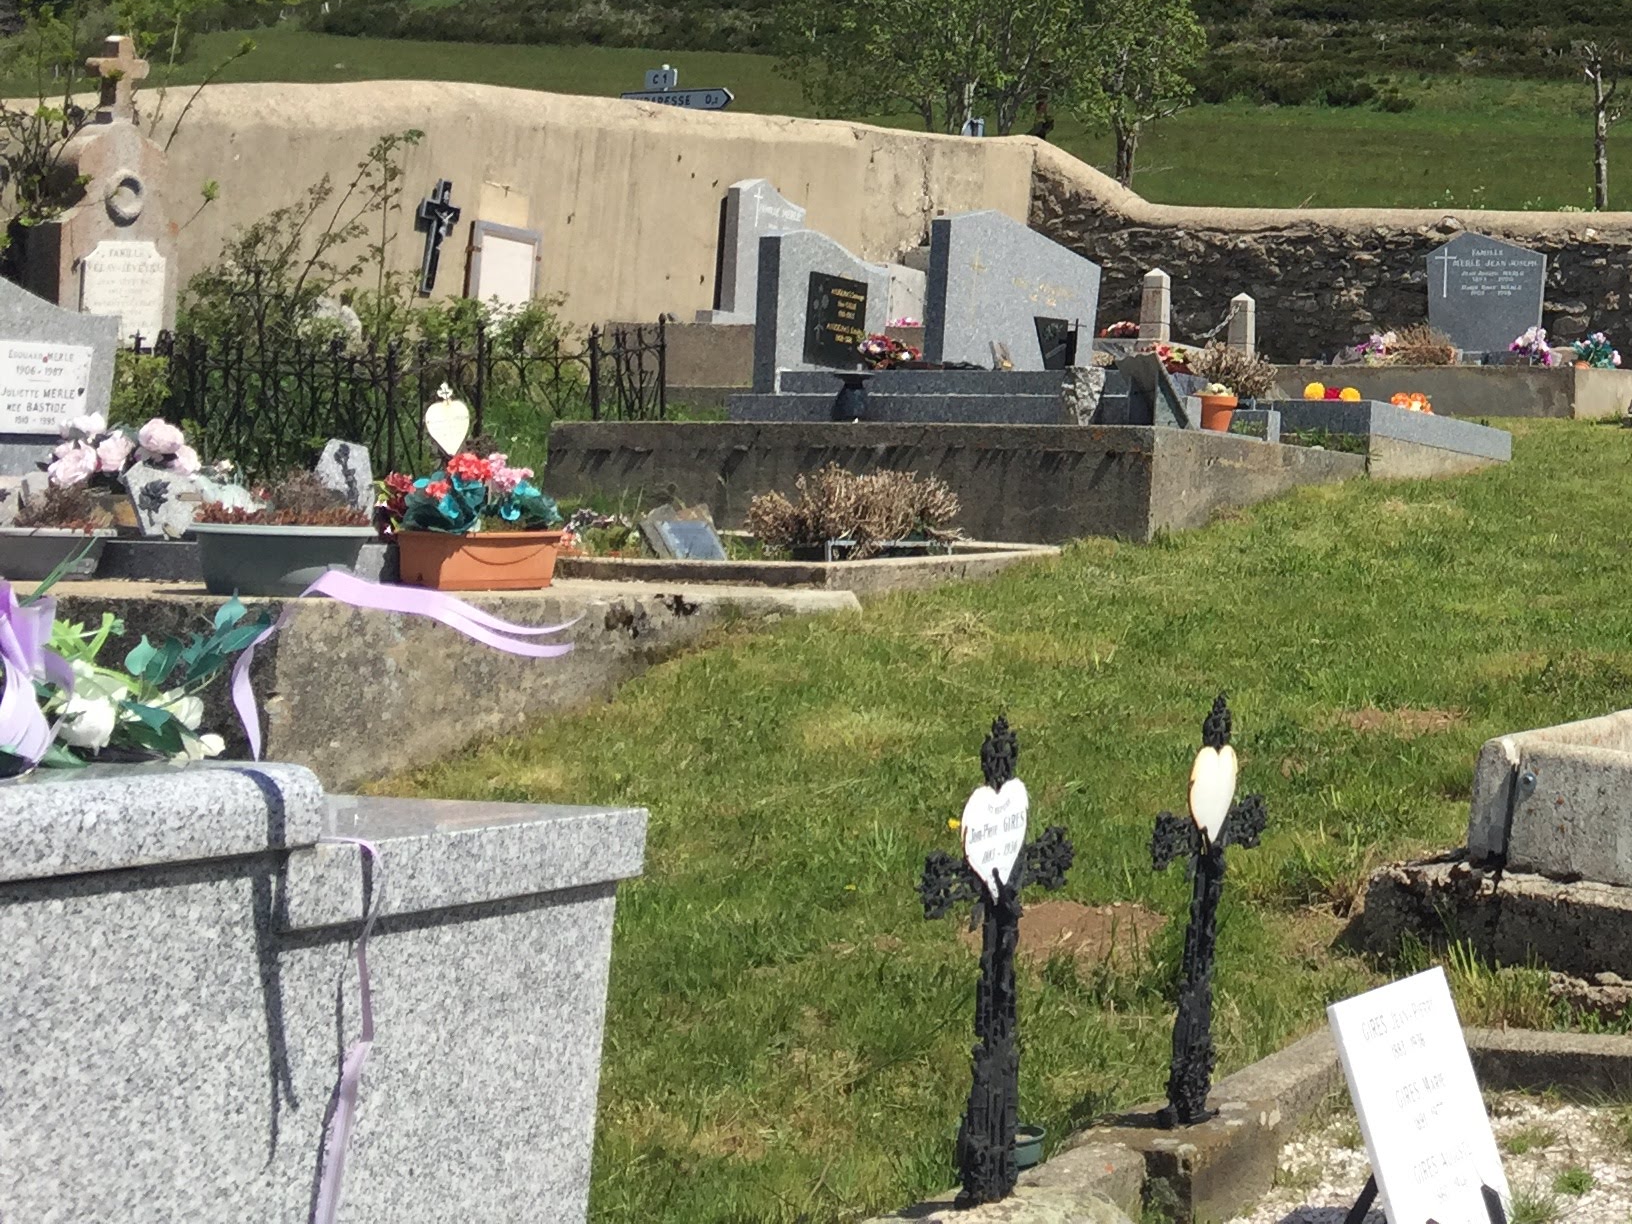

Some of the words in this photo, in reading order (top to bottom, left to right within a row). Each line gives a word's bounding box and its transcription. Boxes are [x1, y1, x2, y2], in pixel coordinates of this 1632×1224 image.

[46, 352, 75, 362] MERLE
[43, 388, 76, 399] MERLE
[26, 402, 67, 413] BASTIDE
[1003, 811, 1025, 833] GIRES
[1361, 1014, 1388, 1042] GIRES
[1395, 1080, 1420, 1108] GIRES
[1412, 1155, 1438, 1185] GIRES
